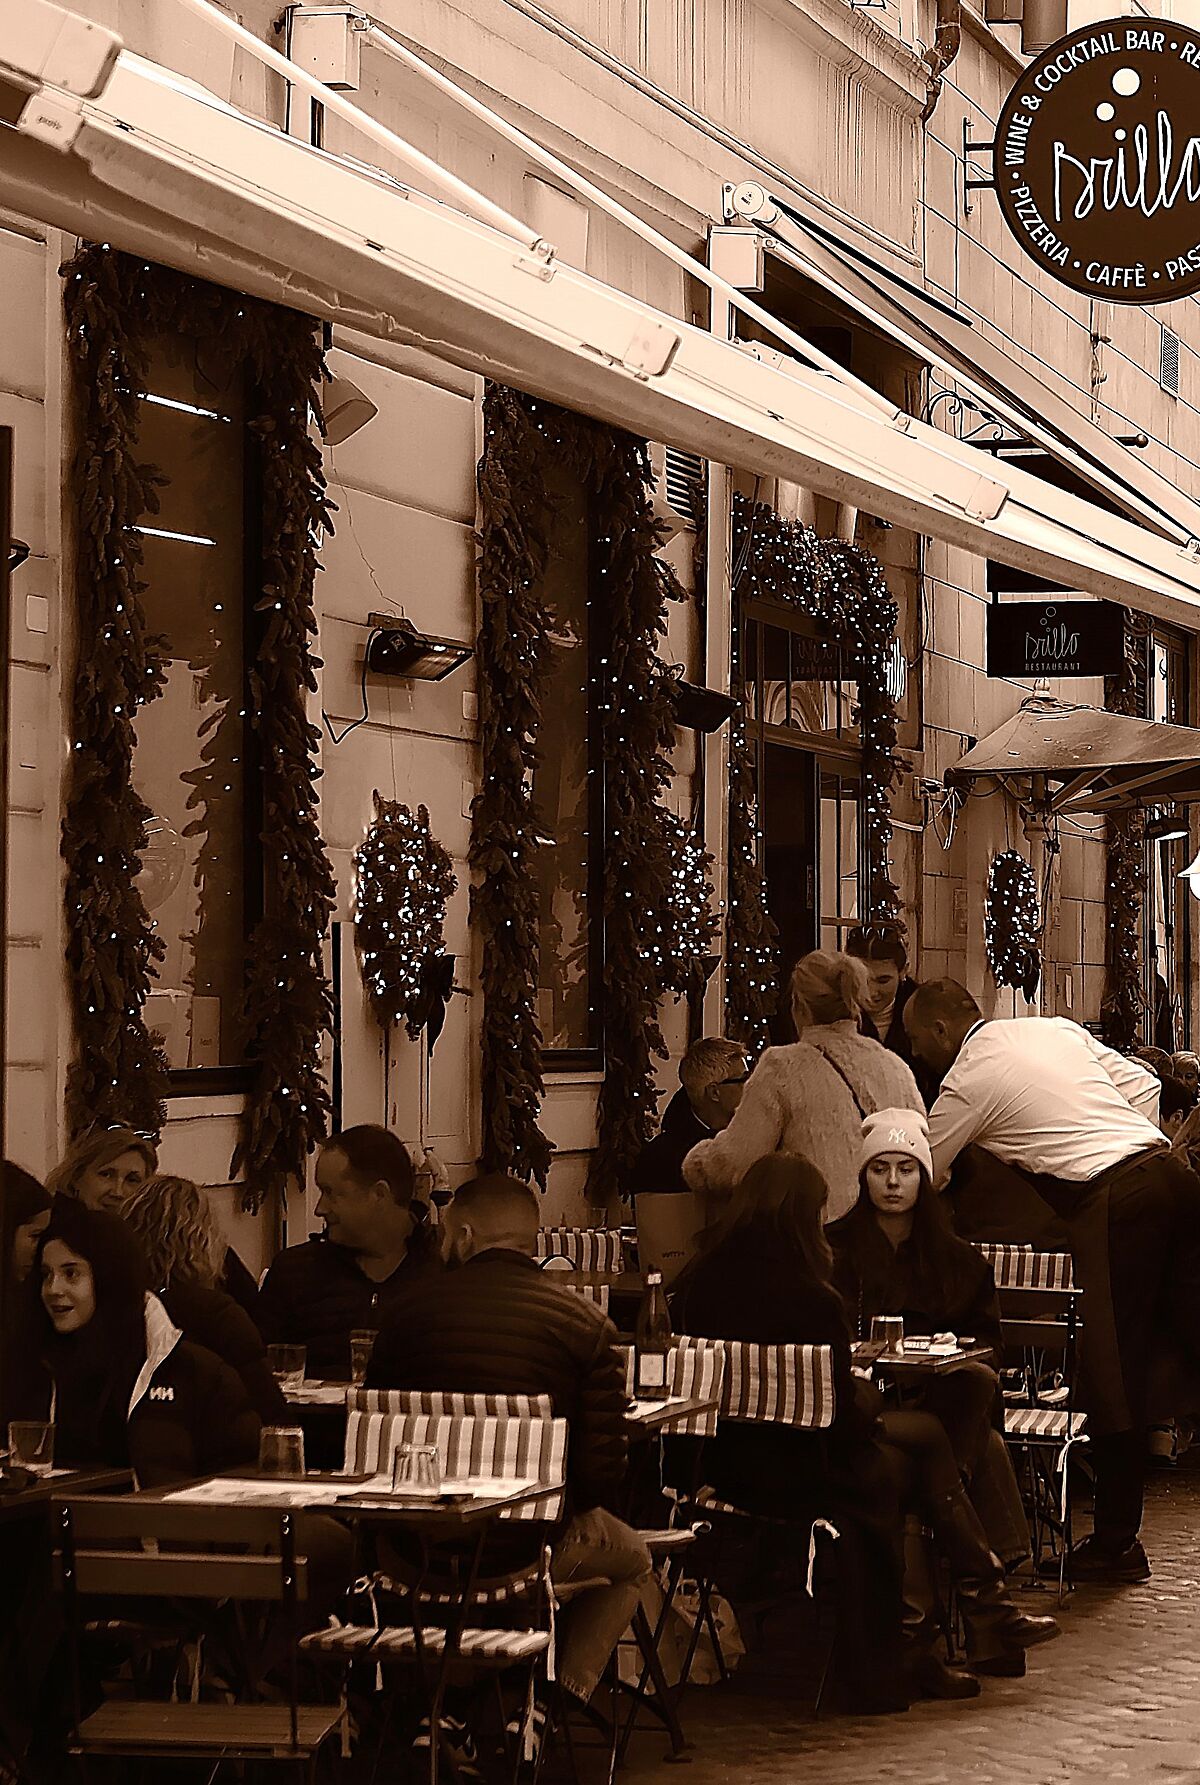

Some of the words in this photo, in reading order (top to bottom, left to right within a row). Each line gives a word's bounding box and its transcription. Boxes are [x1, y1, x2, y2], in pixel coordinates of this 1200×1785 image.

[1004, 112, 1034, 167] WINE
[1020, 94, 1043, 110] &
[1034, 31, 1121, 93] COCKTAIL
[1125, 29, 1165, 53] BAR
[1010, 185, 1071, 267] PIZZERIA
[1085, 261, 1147, 288] CAFFÈ
[1024, 662, 1081, 671] RESTAURANT
